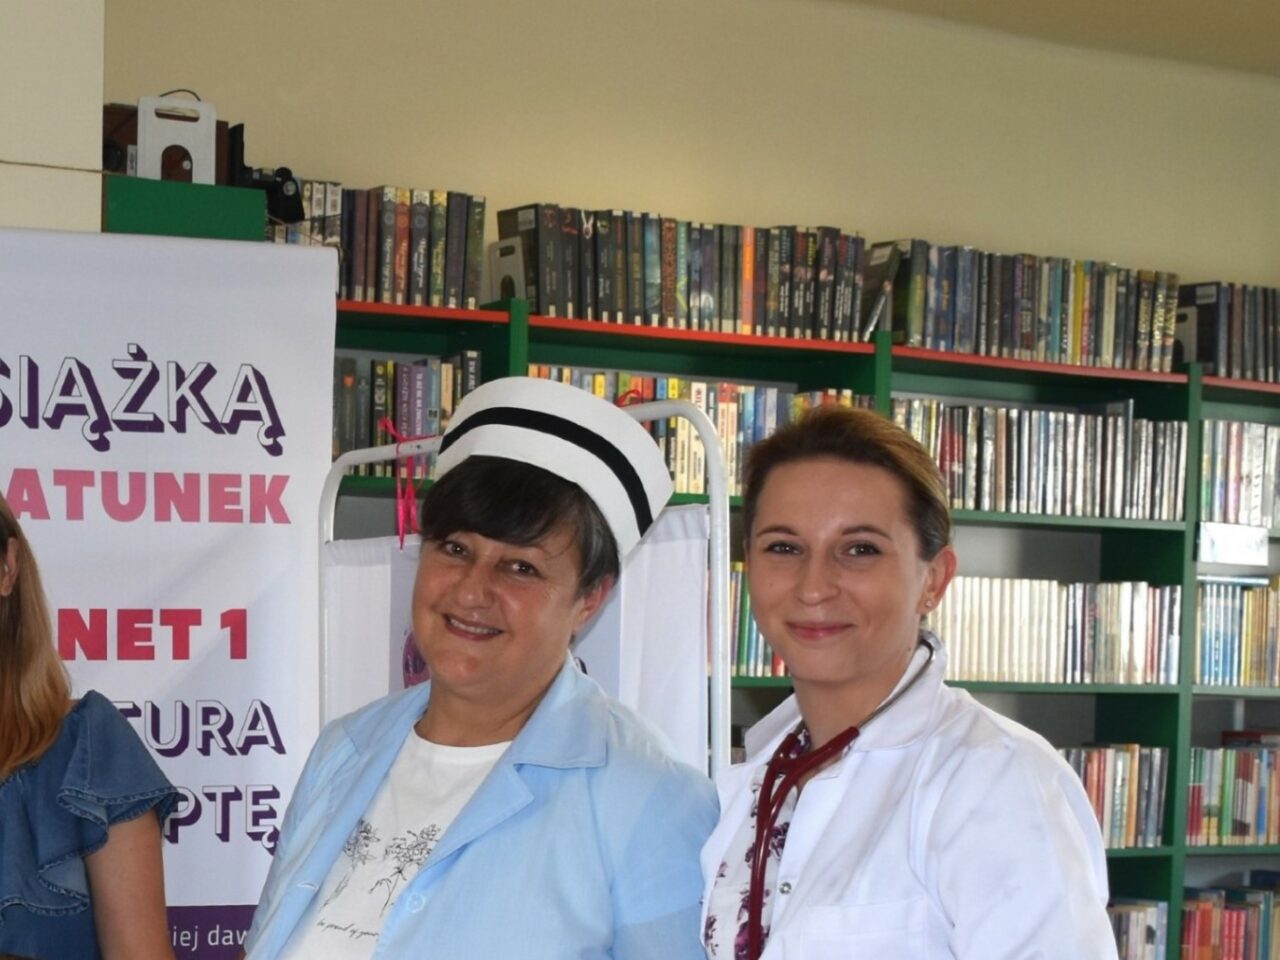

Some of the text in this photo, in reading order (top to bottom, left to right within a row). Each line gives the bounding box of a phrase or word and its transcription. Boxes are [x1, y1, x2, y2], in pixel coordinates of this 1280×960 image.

[10, 466, 293, 525] ATUNEK
[57, 608, 248, 661] NET 1
[163, 783, 281, 857] PTĘ
[172, 924, 198, 951] iej
